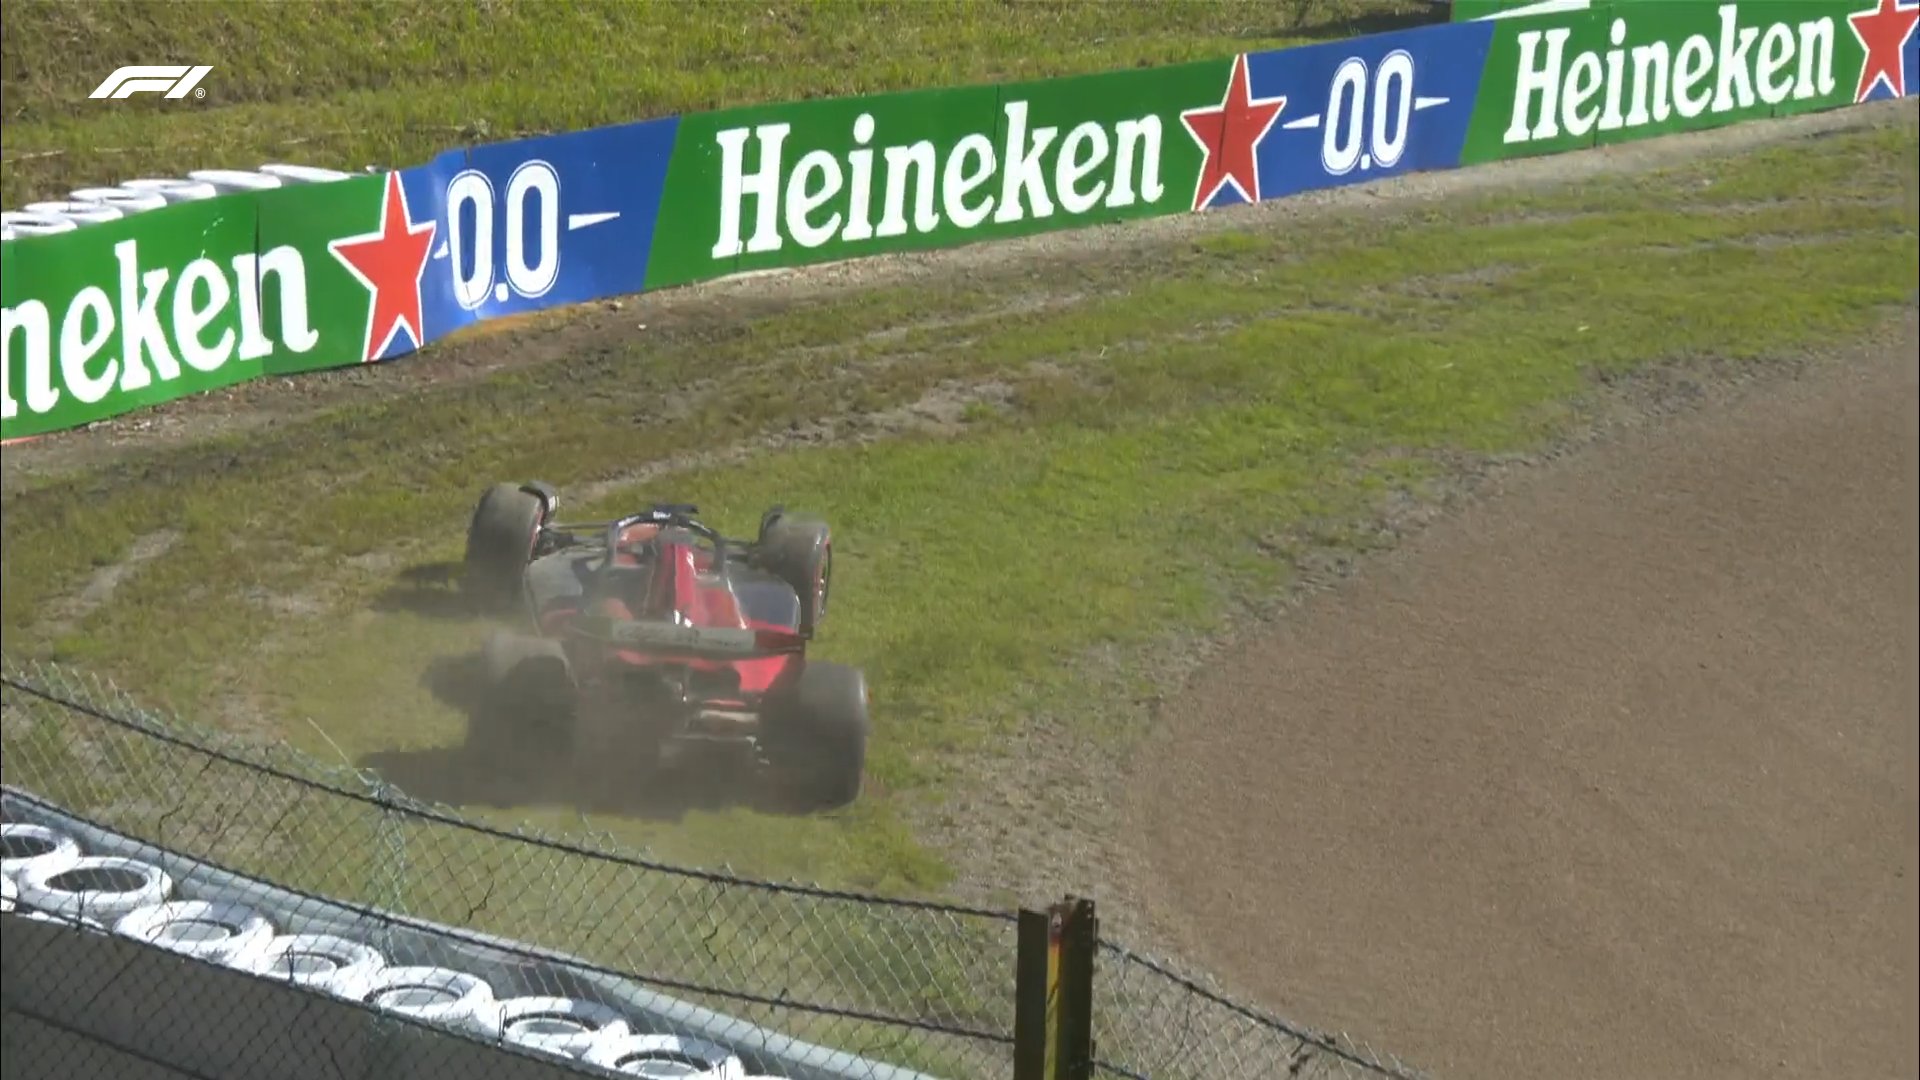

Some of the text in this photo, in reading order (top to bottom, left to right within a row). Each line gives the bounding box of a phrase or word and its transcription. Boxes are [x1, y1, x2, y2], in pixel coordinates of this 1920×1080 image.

[711, 49, 1415, 260] Heineken 0.0
[1503, 4, 1836, 145] Heineken
[0, 159, 562, 418] neken 0.0
